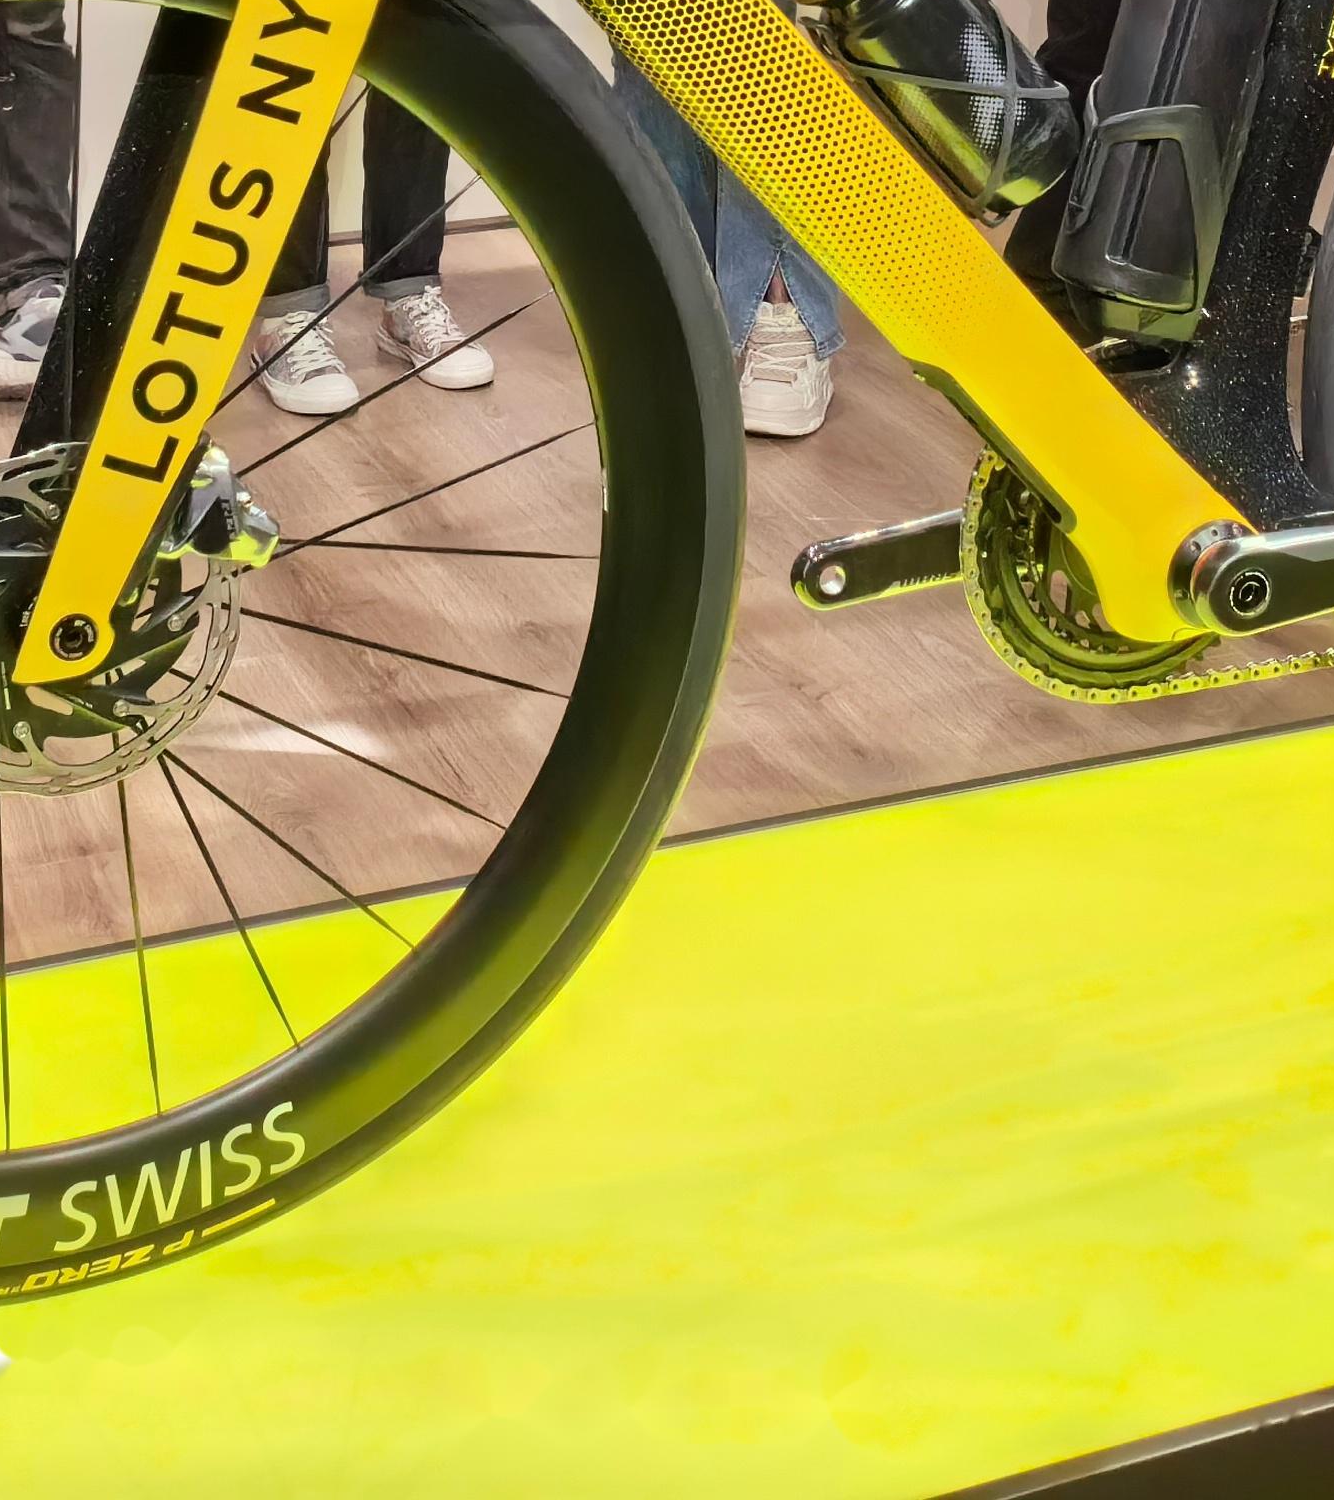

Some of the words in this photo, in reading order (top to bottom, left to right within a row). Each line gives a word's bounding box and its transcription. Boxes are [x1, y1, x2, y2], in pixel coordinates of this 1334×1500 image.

[102, 160, 275, 484] LOTUS
[52, 1100, 307, 1253] SWISS
[21, 1243, 153, 1292] ZERO
[162, 1229, 195, 1257] P
